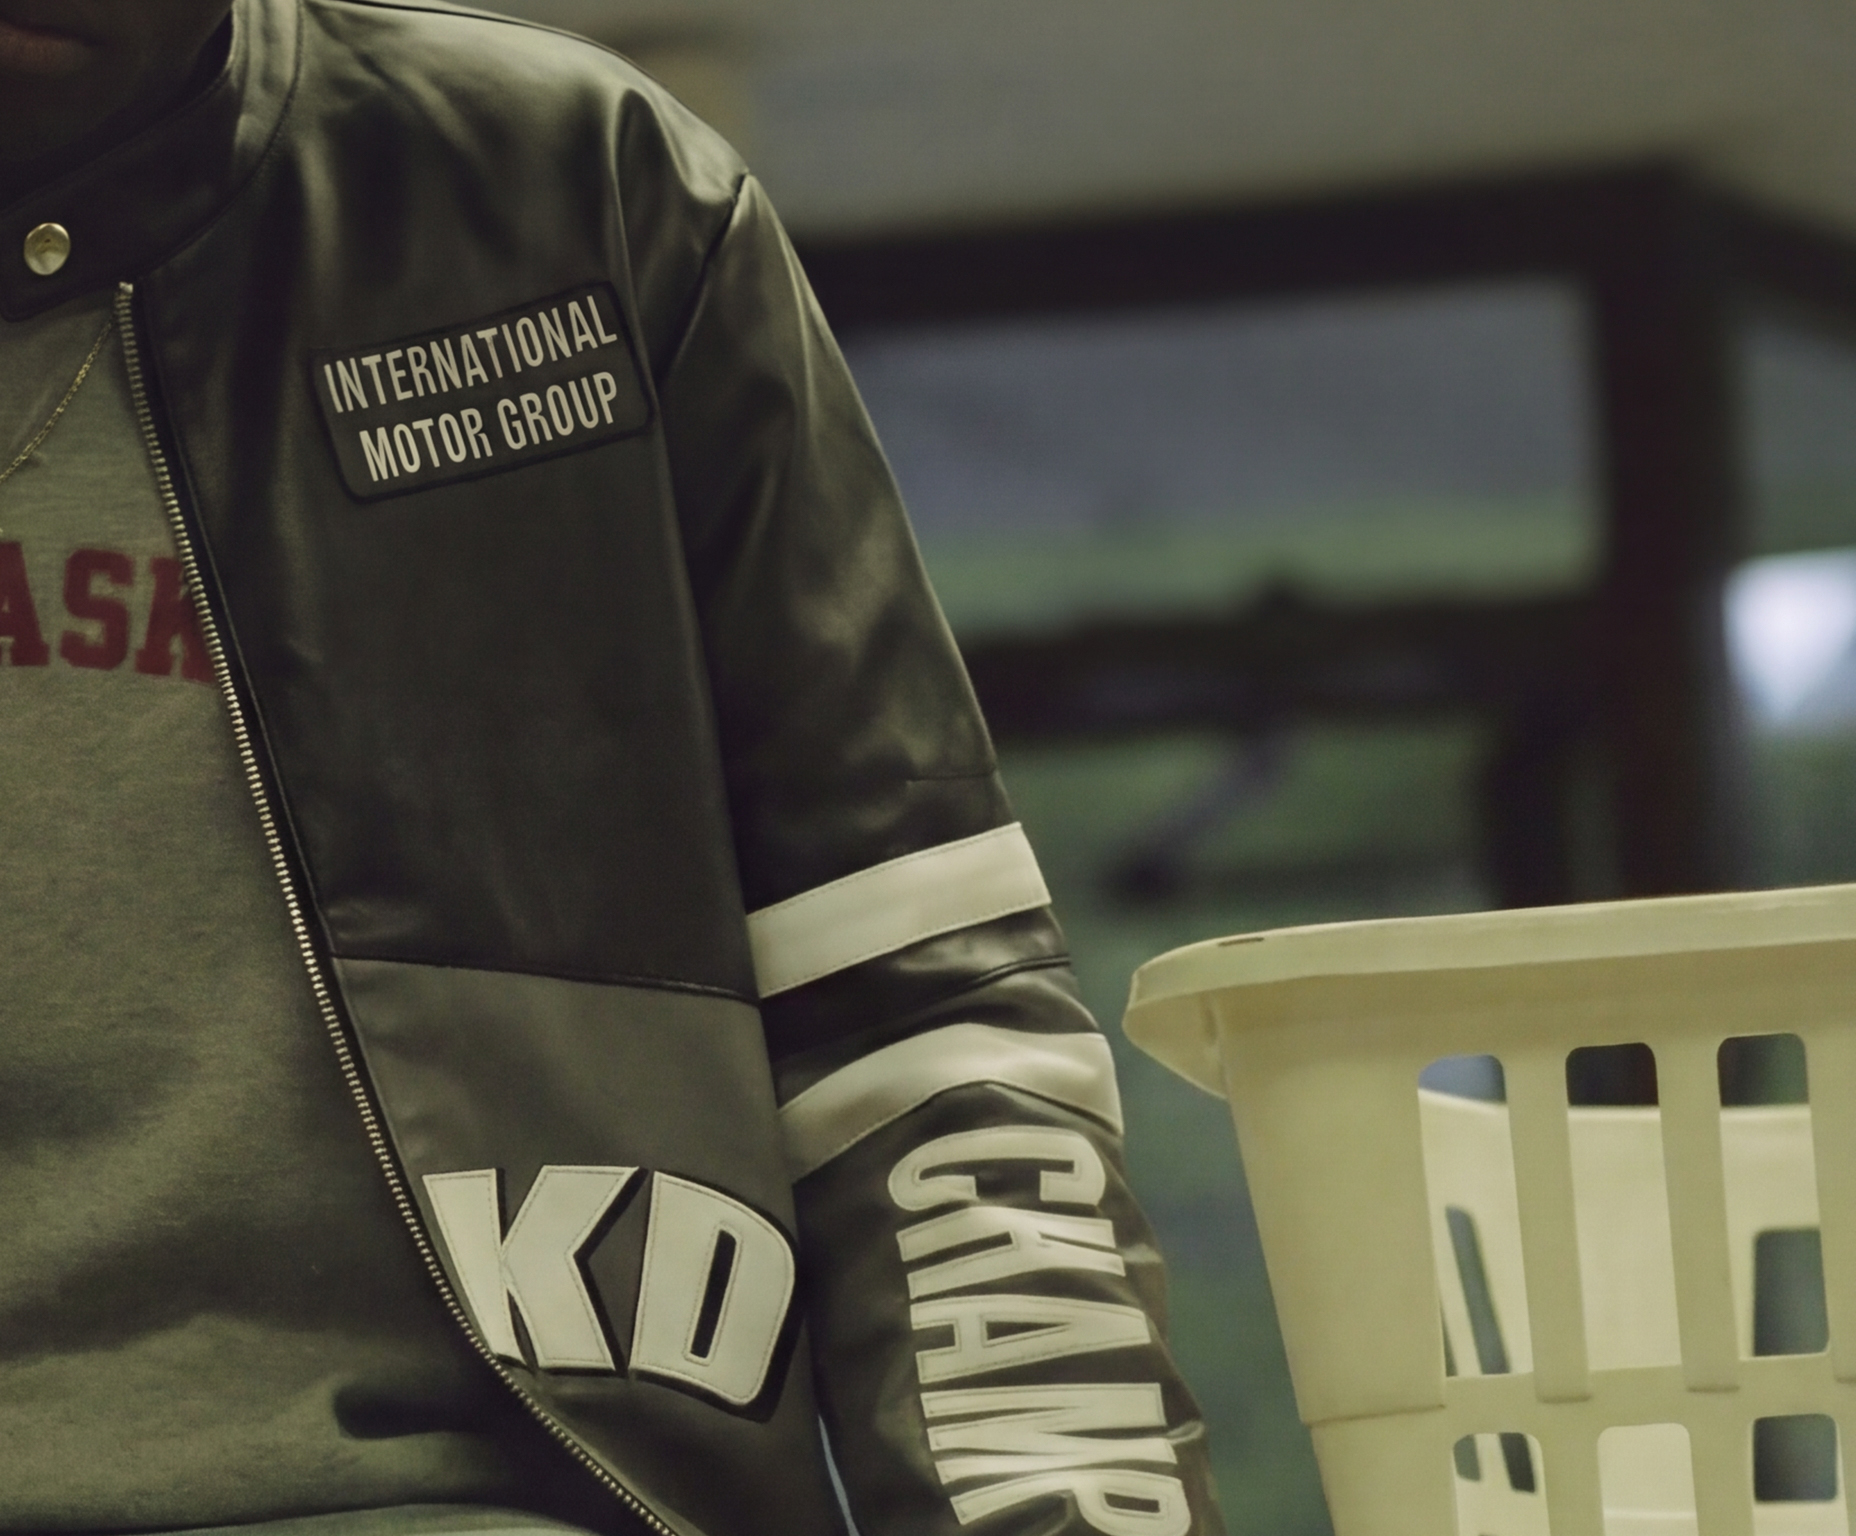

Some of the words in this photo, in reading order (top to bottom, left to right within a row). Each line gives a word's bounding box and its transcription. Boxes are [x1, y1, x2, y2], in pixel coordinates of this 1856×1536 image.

[323, 294, 618, 414] INTERNATIONAL
[358, 406, 494, 483] MOTOR
[495, 370, 618, 451] GROUP
[422, 1164, 796, 1408] KD
